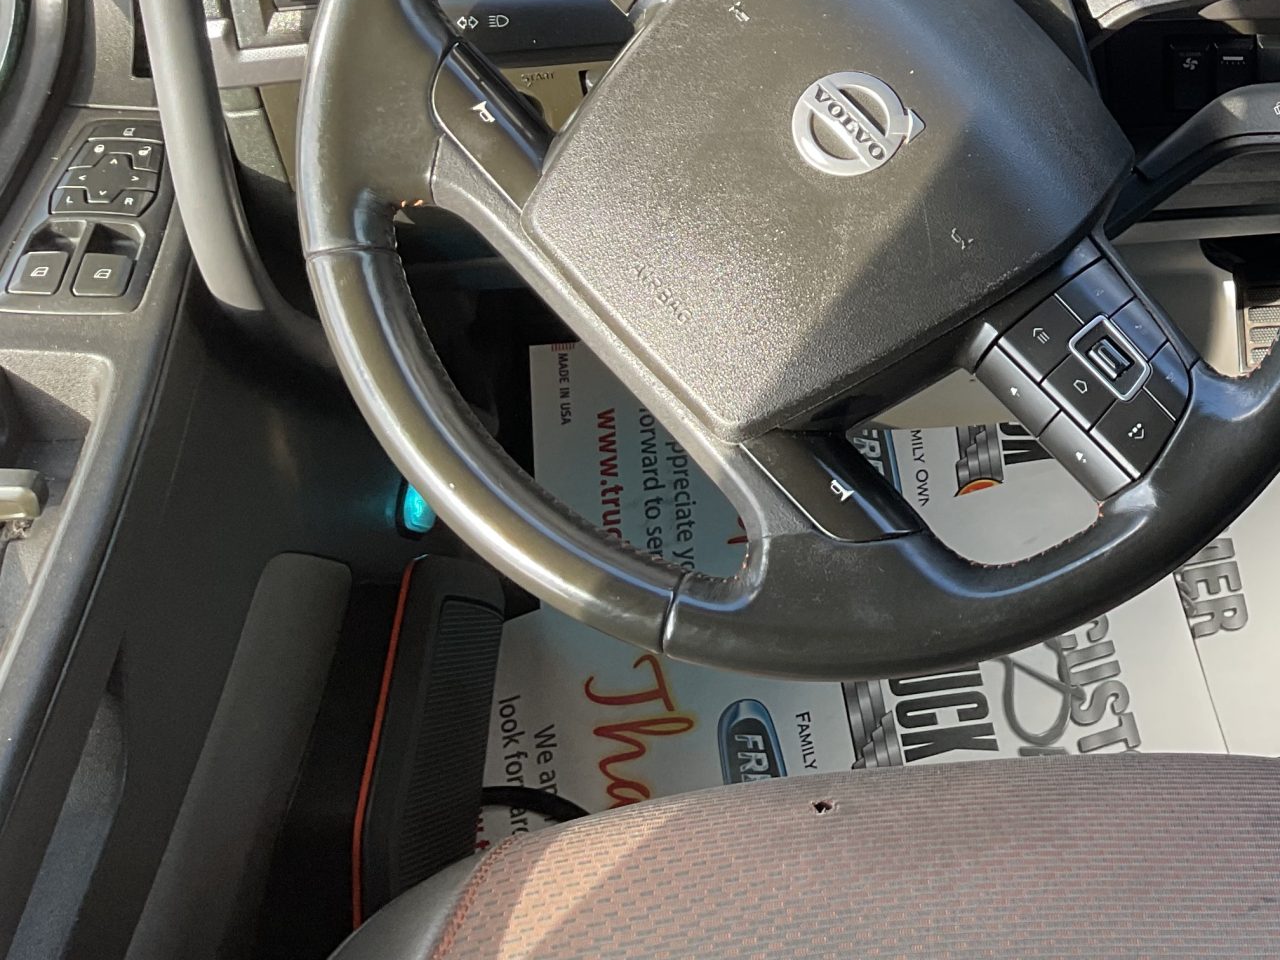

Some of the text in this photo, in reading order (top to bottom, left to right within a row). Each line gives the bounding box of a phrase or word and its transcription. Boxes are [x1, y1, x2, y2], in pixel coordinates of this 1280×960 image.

[814, 83, 885, 160] VOLVO
[65, 195, 74, 204] L
[124, 197, 134, 206] R
[558, 352, 571, 426] MADE IN USA
[910, 429, 926, 462] MILY
[596, 408, 624, 543] www.truc
[648, 495, 664, 521] to
[498, 694, 526, 749] look
[534, 724, 557, 765] We
[796, 710, 818, 770] FAMILY
